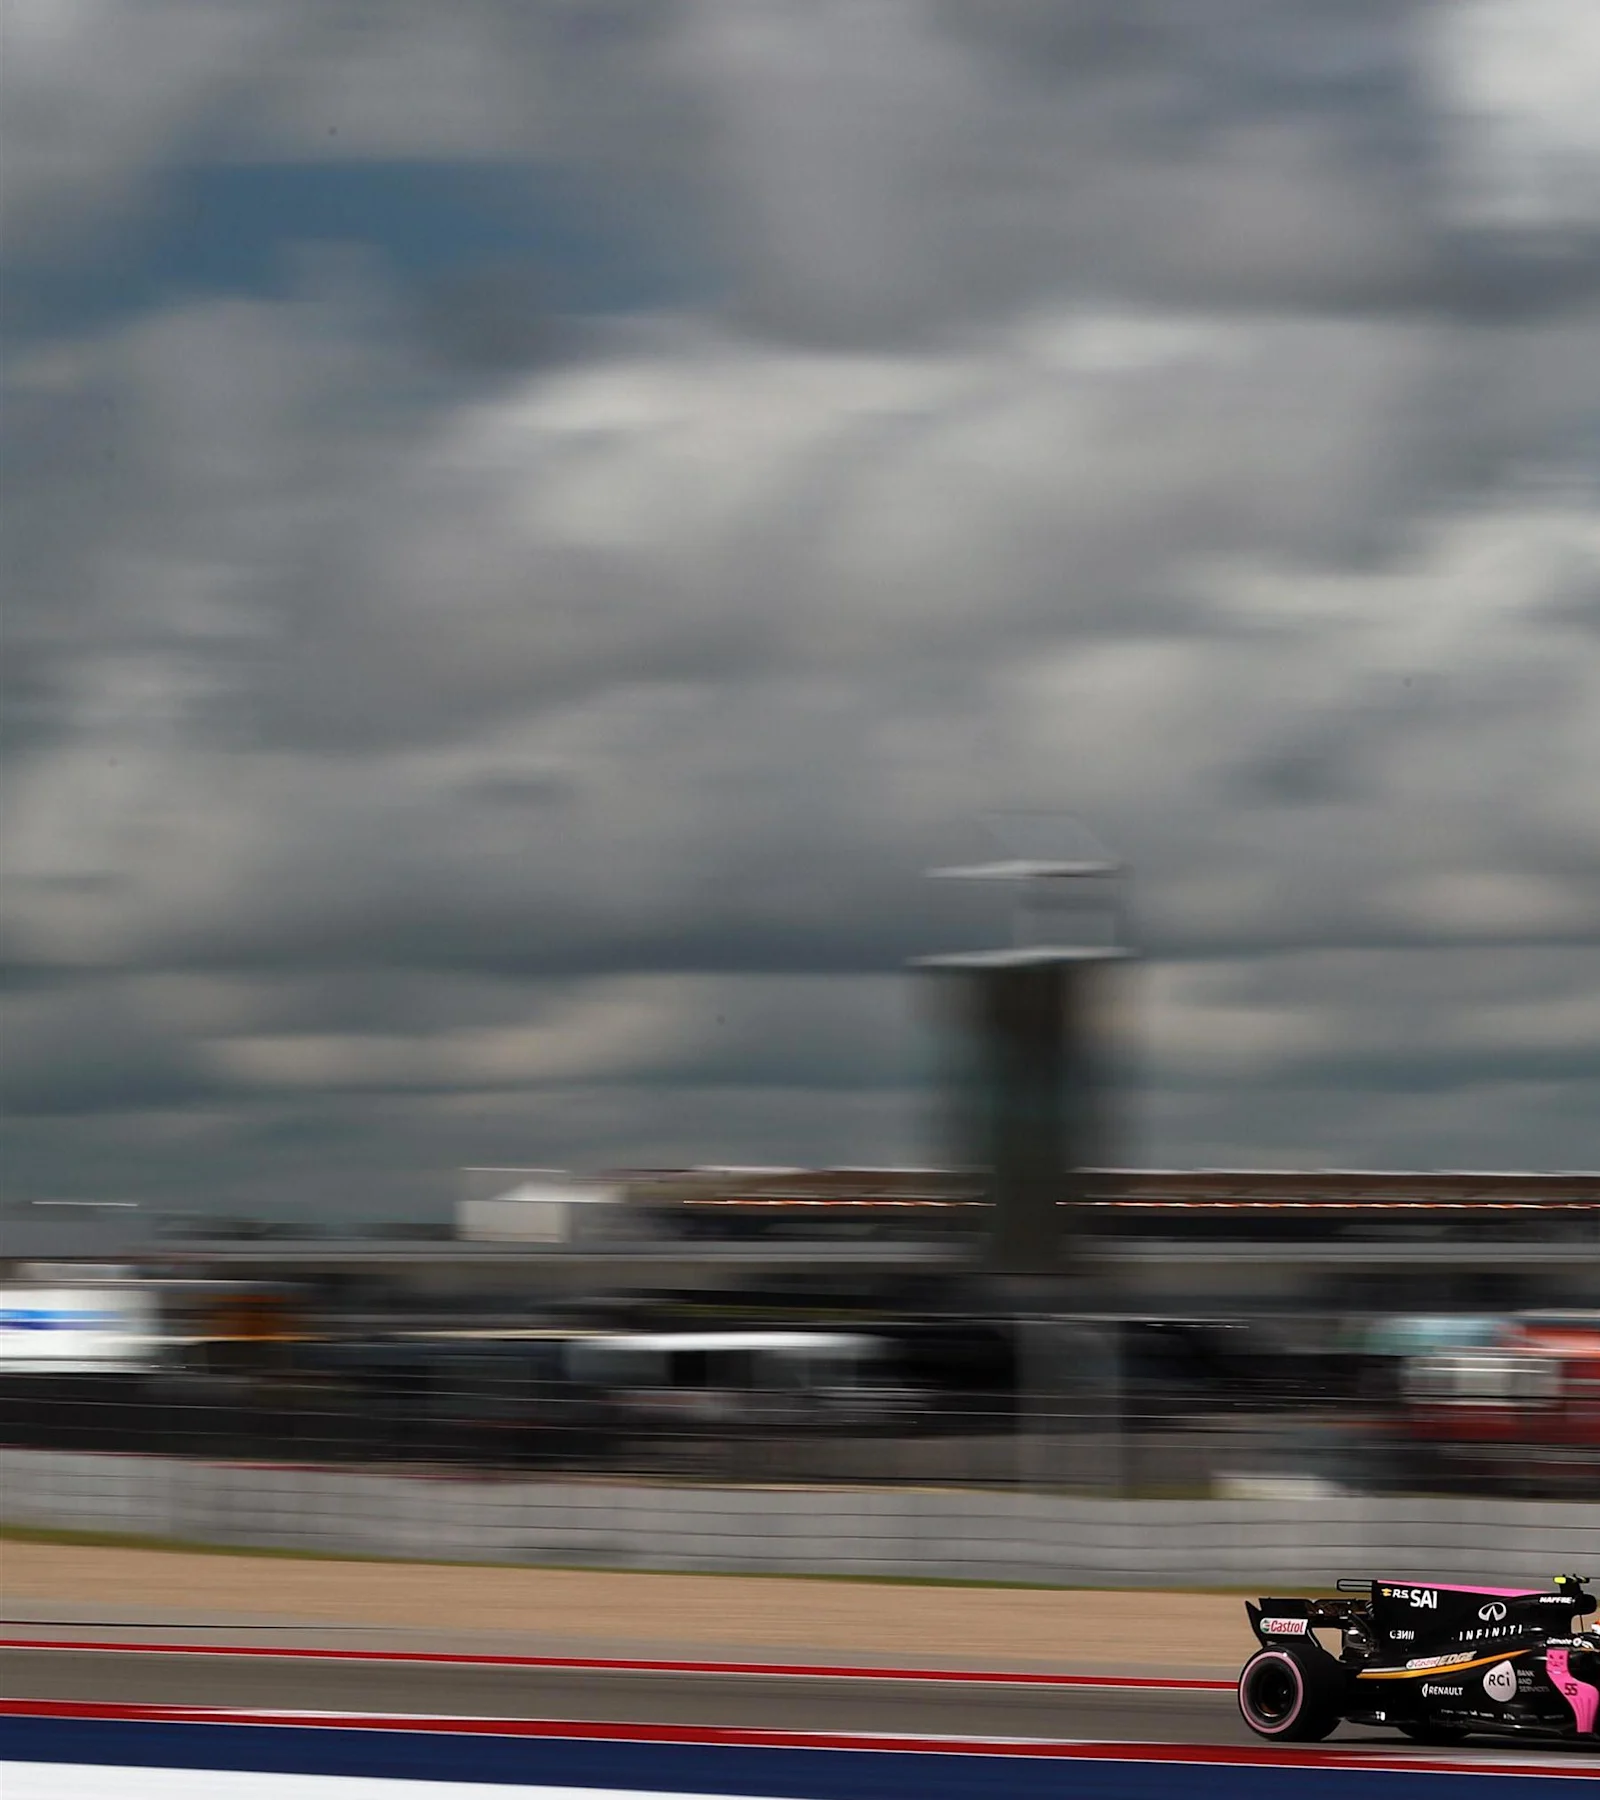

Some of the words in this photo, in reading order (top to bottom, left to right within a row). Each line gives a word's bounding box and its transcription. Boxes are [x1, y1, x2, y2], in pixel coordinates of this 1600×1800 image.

[1410, 1589, 1438, 1609] SAI
[1270, 1620, 1304, 1633] Castrol
[1459, 1624, 1523, 1641] INFINITI
[1437, 1650, 1477, 1666] EDGE
[1428, 1685, 1464, 1696] RENAULT
[1564, 1682, 1578, 1696] 55
